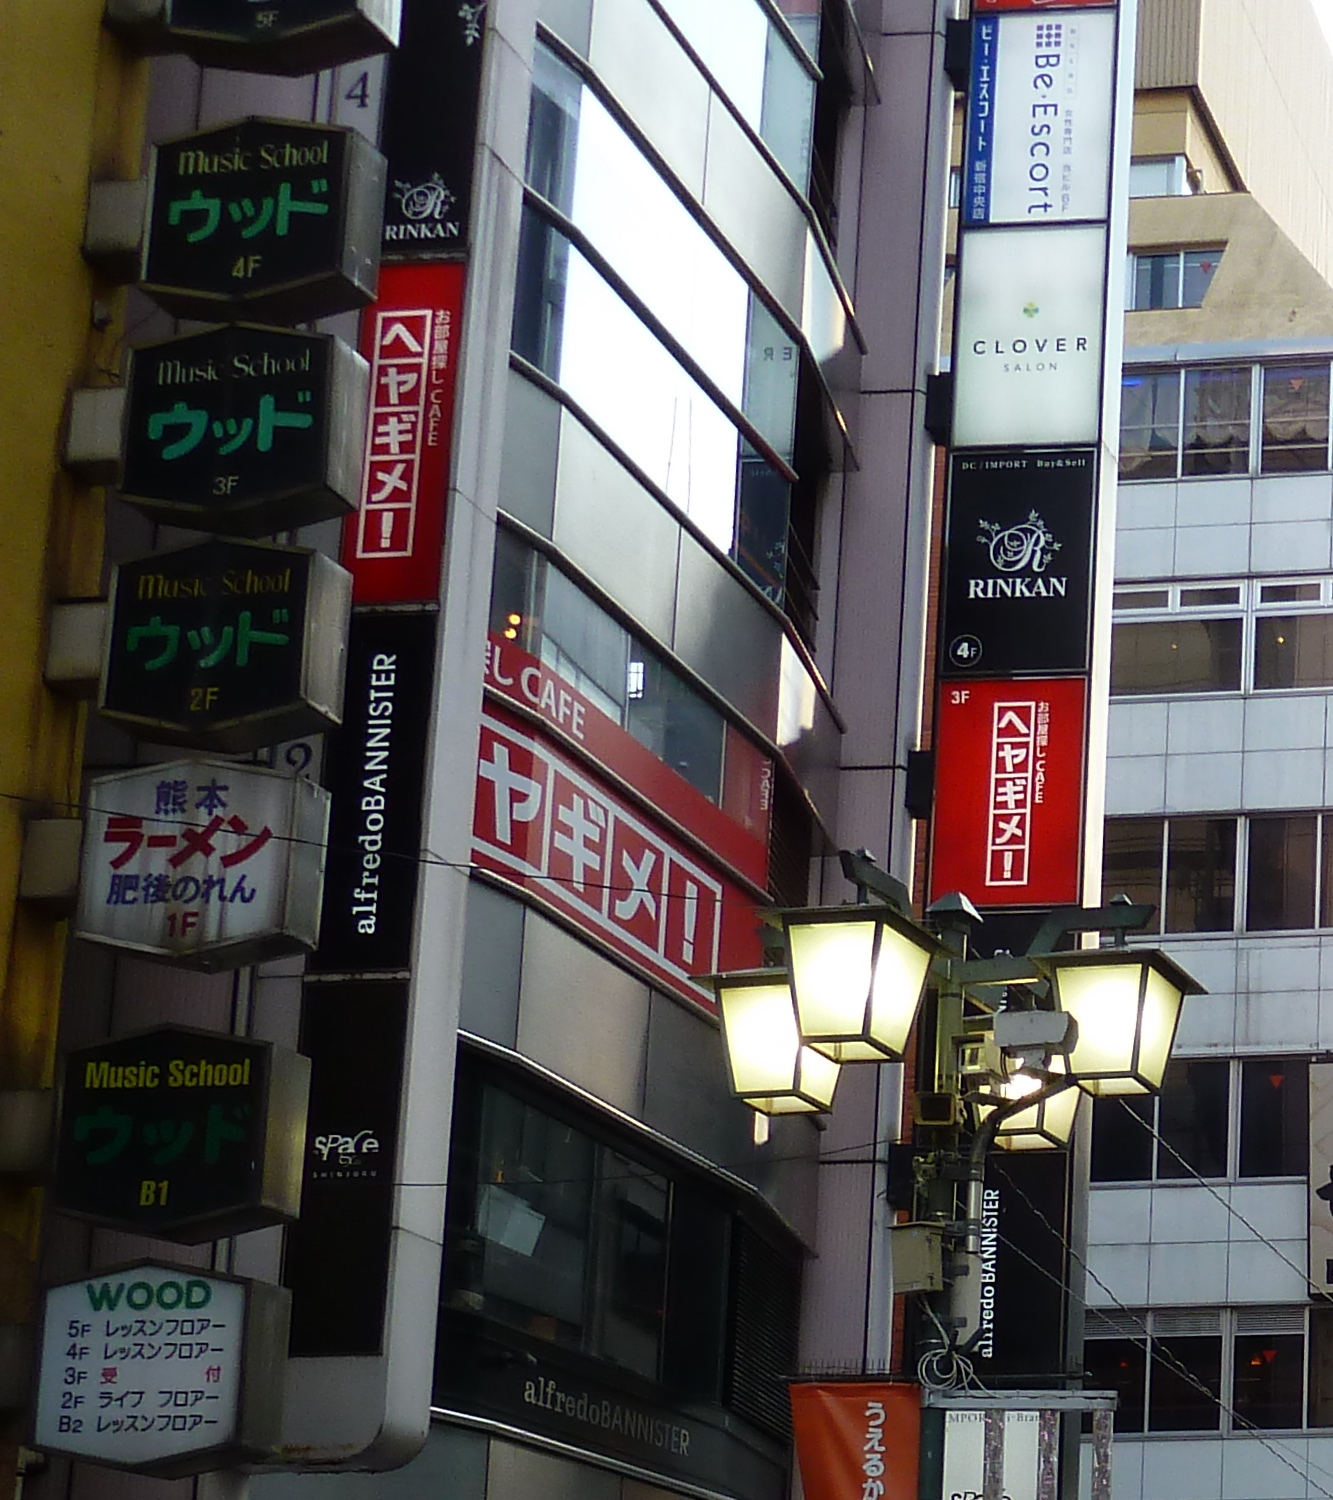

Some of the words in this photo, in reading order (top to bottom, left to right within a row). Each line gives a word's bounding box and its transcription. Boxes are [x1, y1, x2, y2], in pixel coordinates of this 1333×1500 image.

[344, 71, 371, 108] 4
[178, 147, 251, 176] Music
[259, 140, 330, 169] School
[169, 178, 330, 243] ウッド
[384, 222, 460, 241] RINKAN
[232, 255, 262, 279] 4F
[430, 309, 452, 387] お部屋探し
[973, 338, 1089, 355] CLOVER
[158, 360, 220, 387] Music
[232, 351, 312, 379] School
[1003, 362, 1058, 373] SALON
[147, 393, 314, 461] ウッド
[426, 389, 442, 447] CAFE
[213, 476, 239, 495] 3F
[138, 576, 205, 600] Music
[221, 568, 291, 596] School
[967, 577, 1067, 600] RINKAN
[126, 606, 290, 671] ウッド
[956, 642, 978, 660] 4F
[190, 687, 220, 711] 2F
[520, 667, 587, 740] CAFE
[951, 691, 971, 705] 3F
[155, 779, 229, 816] 熊本
[104, 814, 273, 869] ラーメン
[106, 874, 257, 905] 肥後のれん
[167, 912, 199, 937] 1F
[85, 1059, 160, 1089] Music
[167, 1056, 251, 1087] School
[74, 1105, 253, 1167] ウッド
[139, 1178, 169, 1208] B1
[86, 1280, 213, 1311] WOOD
[67, 1319, 92, 1338] 5F
[105, 1318, 227, 1338] レッスンフロアー
[65, 1343, 90, 1361] 4F
[103, 1342, 225, 1361] レッスンフロアー
[63, 1366, 88, 1385] 3F
[100, 1367, 118, 1385] 受
[205, 1365, 222, 1384] 付
[61, 1391, 86, 1409] 2F
[157, 1390, 220, 1408] フロアー
[58, 1415, 83, 1434] B2
[96, 1415, 218, 1433] レッスンフロアー
